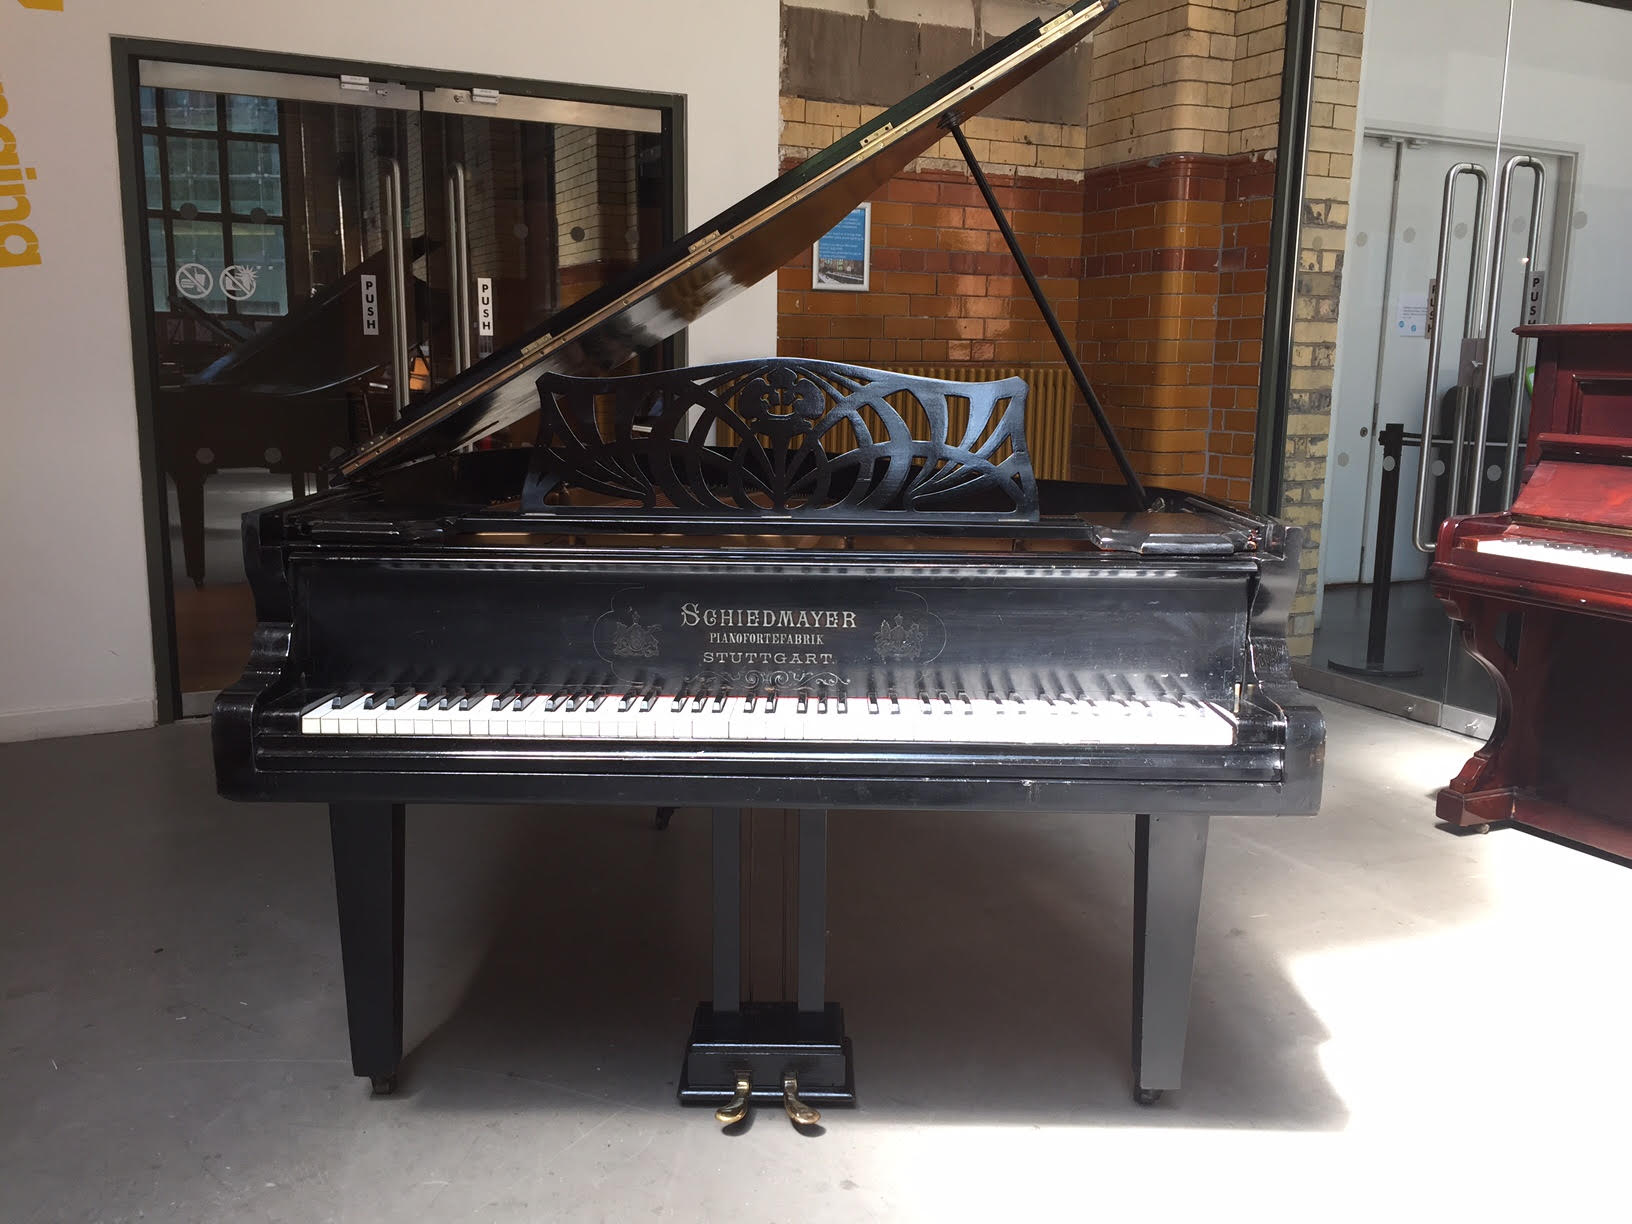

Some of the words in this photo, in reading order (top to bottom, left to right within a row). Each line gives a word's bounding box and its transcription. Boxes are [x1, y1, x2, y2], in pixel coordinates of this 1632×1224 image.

[366, 281, 376, 329] PUSH
[481, 284, 491, 330] PUSH
[680, 602, 857, 628] SCHIEDMAYER
[710, 632, 825, 645] PIANOFORTEFABRIK
